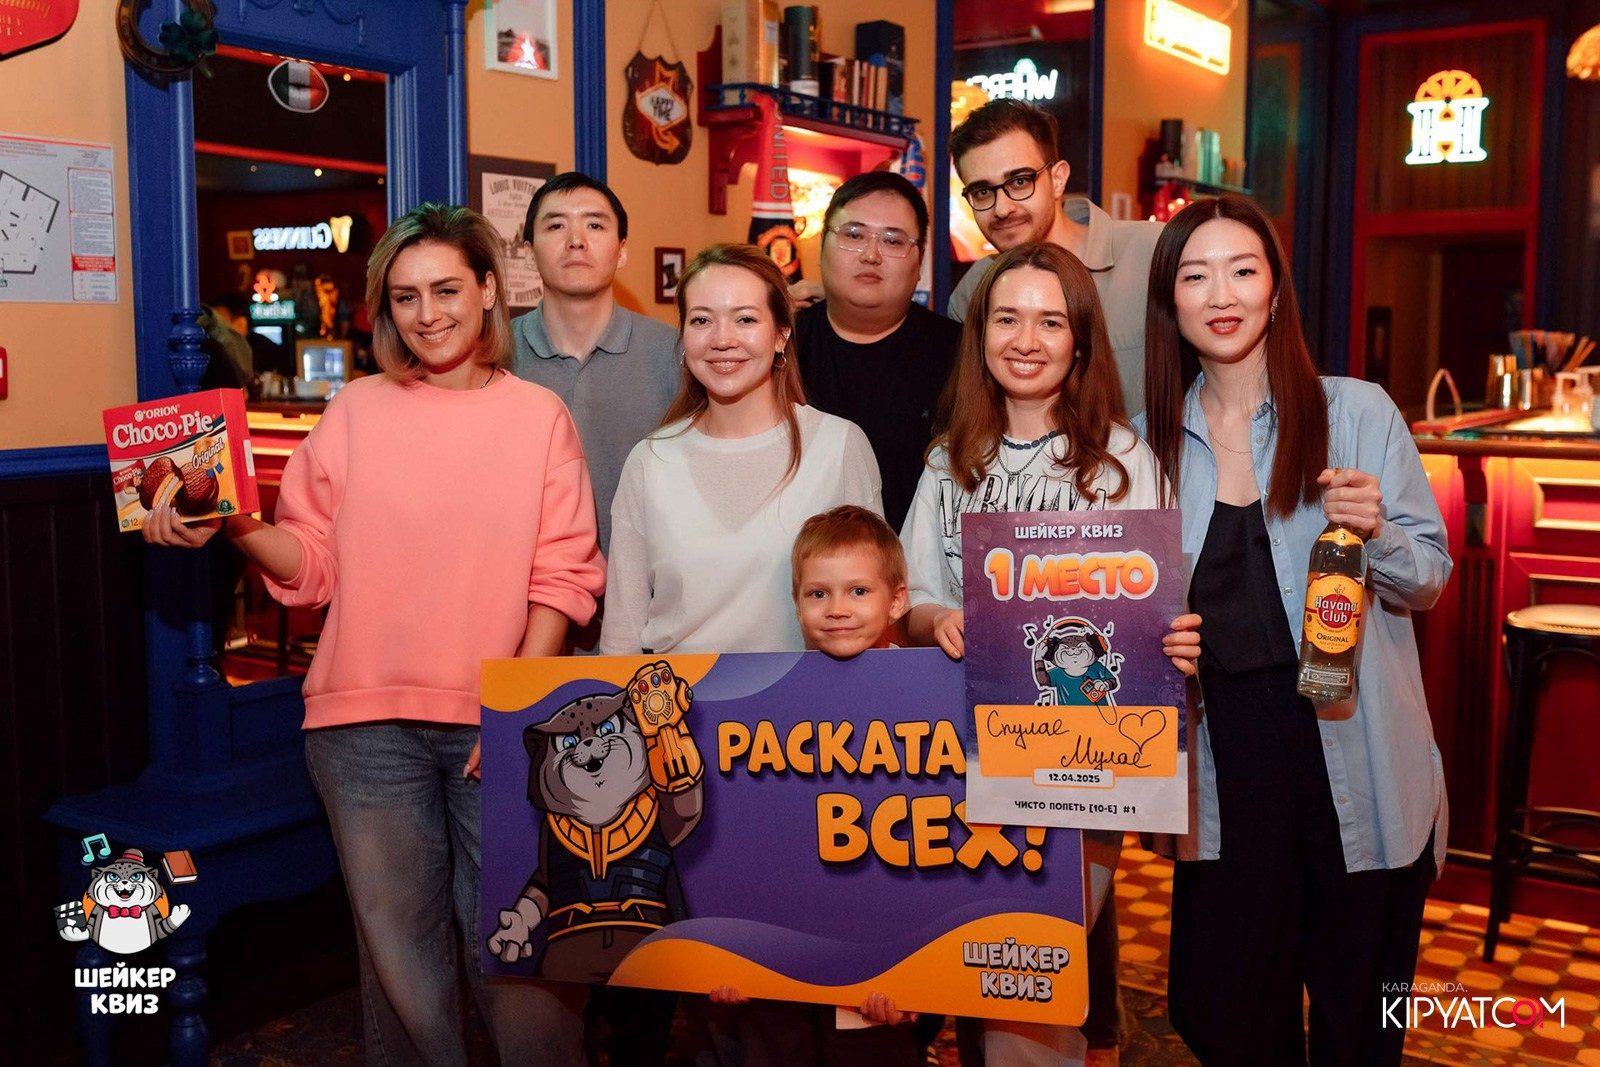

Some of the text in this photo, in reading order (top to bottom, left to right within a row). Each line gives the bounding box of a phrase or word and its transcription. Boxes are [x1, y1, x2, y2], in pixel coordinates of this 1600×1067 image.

[145, 405, 178, 419] ORION
[192, 437, 225, 470] Original
[130, 518, 139, 526] 12
[1015, 523, 1123, 539] ШЕЙКЕР КВИЗ
[1340, 532, 1347, 541] 3
[986, 550, 1156, 599] 1 МЕСТО
[1315, 596, 1357, 612] Havana
[1321, 609, 1348, 623] Club
[717, 720, 966, 778] РАСКАТА
[1048, 773, 1100, 783] 12.04.2025
[1014, 800, 1046, 810] ЧИСТО
[1050, 802, 1086, 812] ПОПЕТЬ
[1123, 806, 1136, 814] #1
[816, 793, 1047, 876] ВСЕХ!
[963, 938, 1070, 972] ШЕЙКЕР
[980, 971, 1053, 1002] КВИЗ
